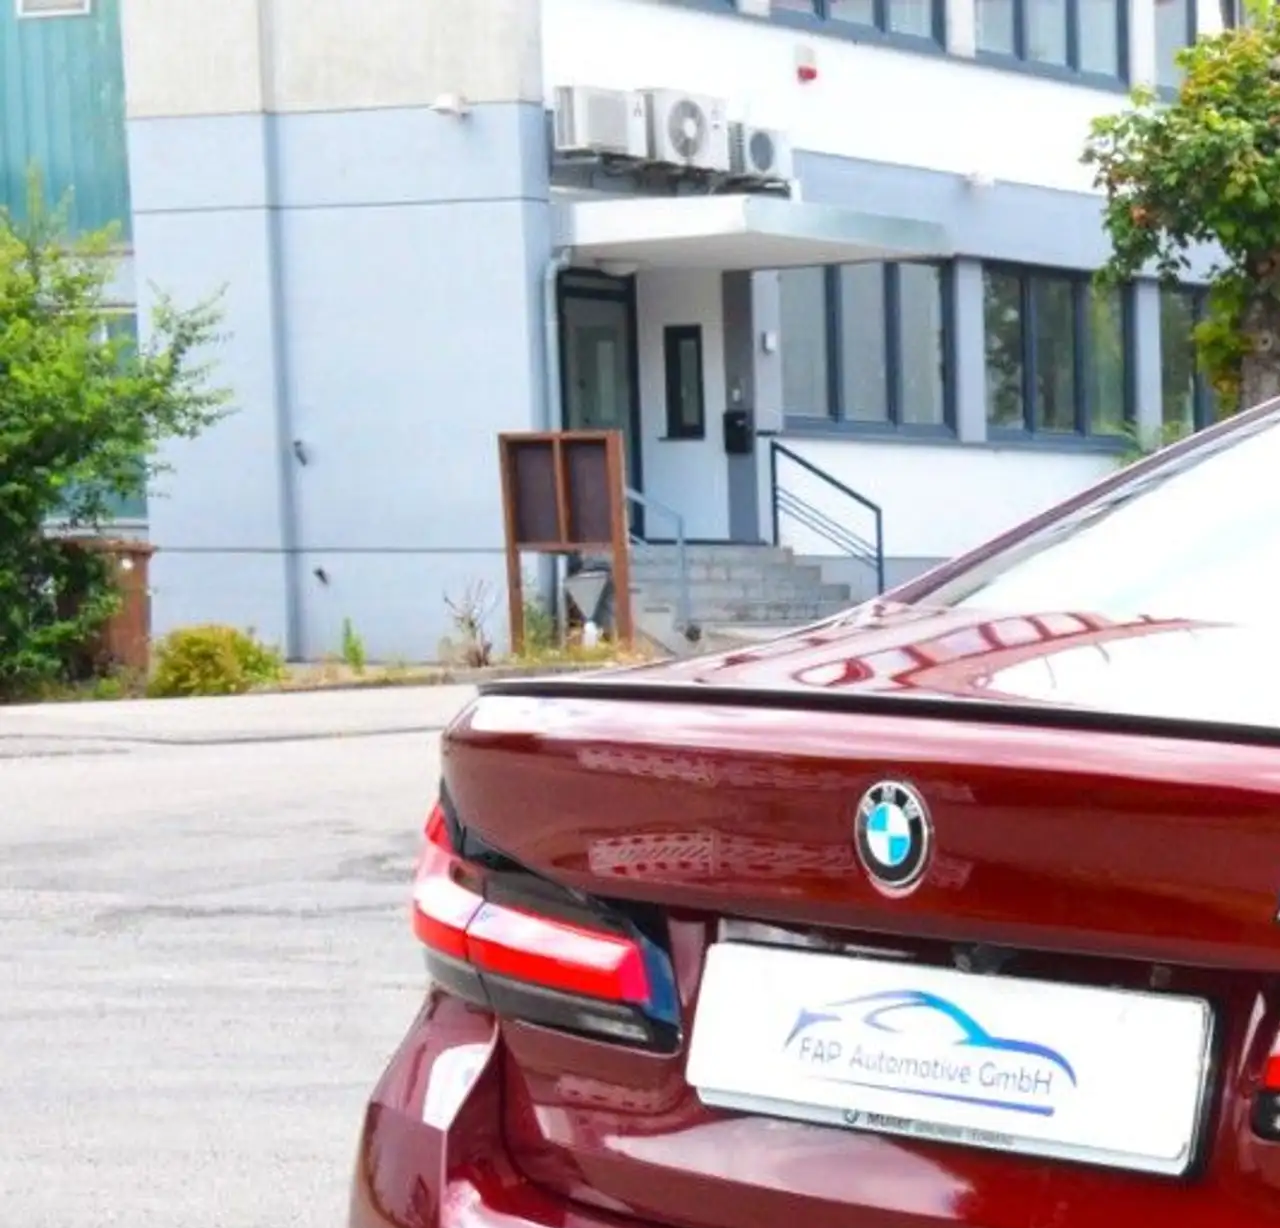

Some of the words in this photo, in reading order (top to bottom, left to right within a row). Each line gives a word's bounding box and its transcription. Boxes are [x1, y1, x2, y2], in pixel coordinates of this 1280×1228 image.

[799, 1037, 842, 1063] FAP
[849, 1045, 971, 1083] Automotive
[978, 1061, 1053, 1094] GmbH
